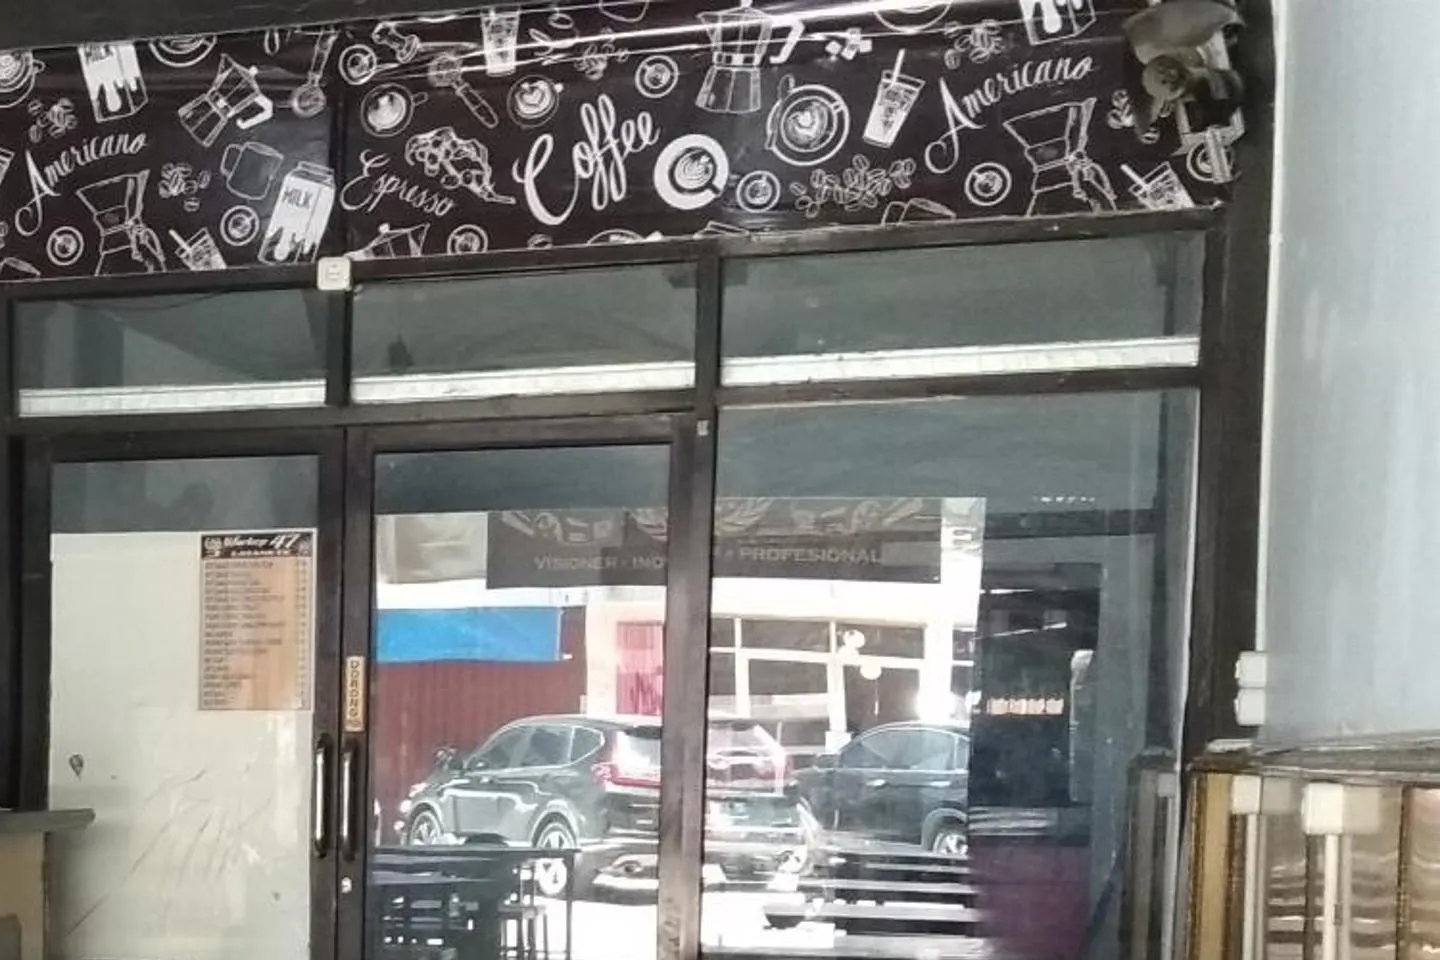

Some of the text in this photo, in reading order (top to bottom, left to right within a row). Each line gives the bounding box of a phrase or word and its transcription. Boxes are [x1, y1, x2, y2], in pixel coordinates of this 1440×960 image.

[925, 53, 1098, 173] Americano
[15, 132, 149, 236] Americano
[281, 186, 315, 209] MILK
[341, 151, 459, 216] Espresso
[512, 95, 663, 224] Coffee
[739, 545, 882, 563] PROFESIONAL
